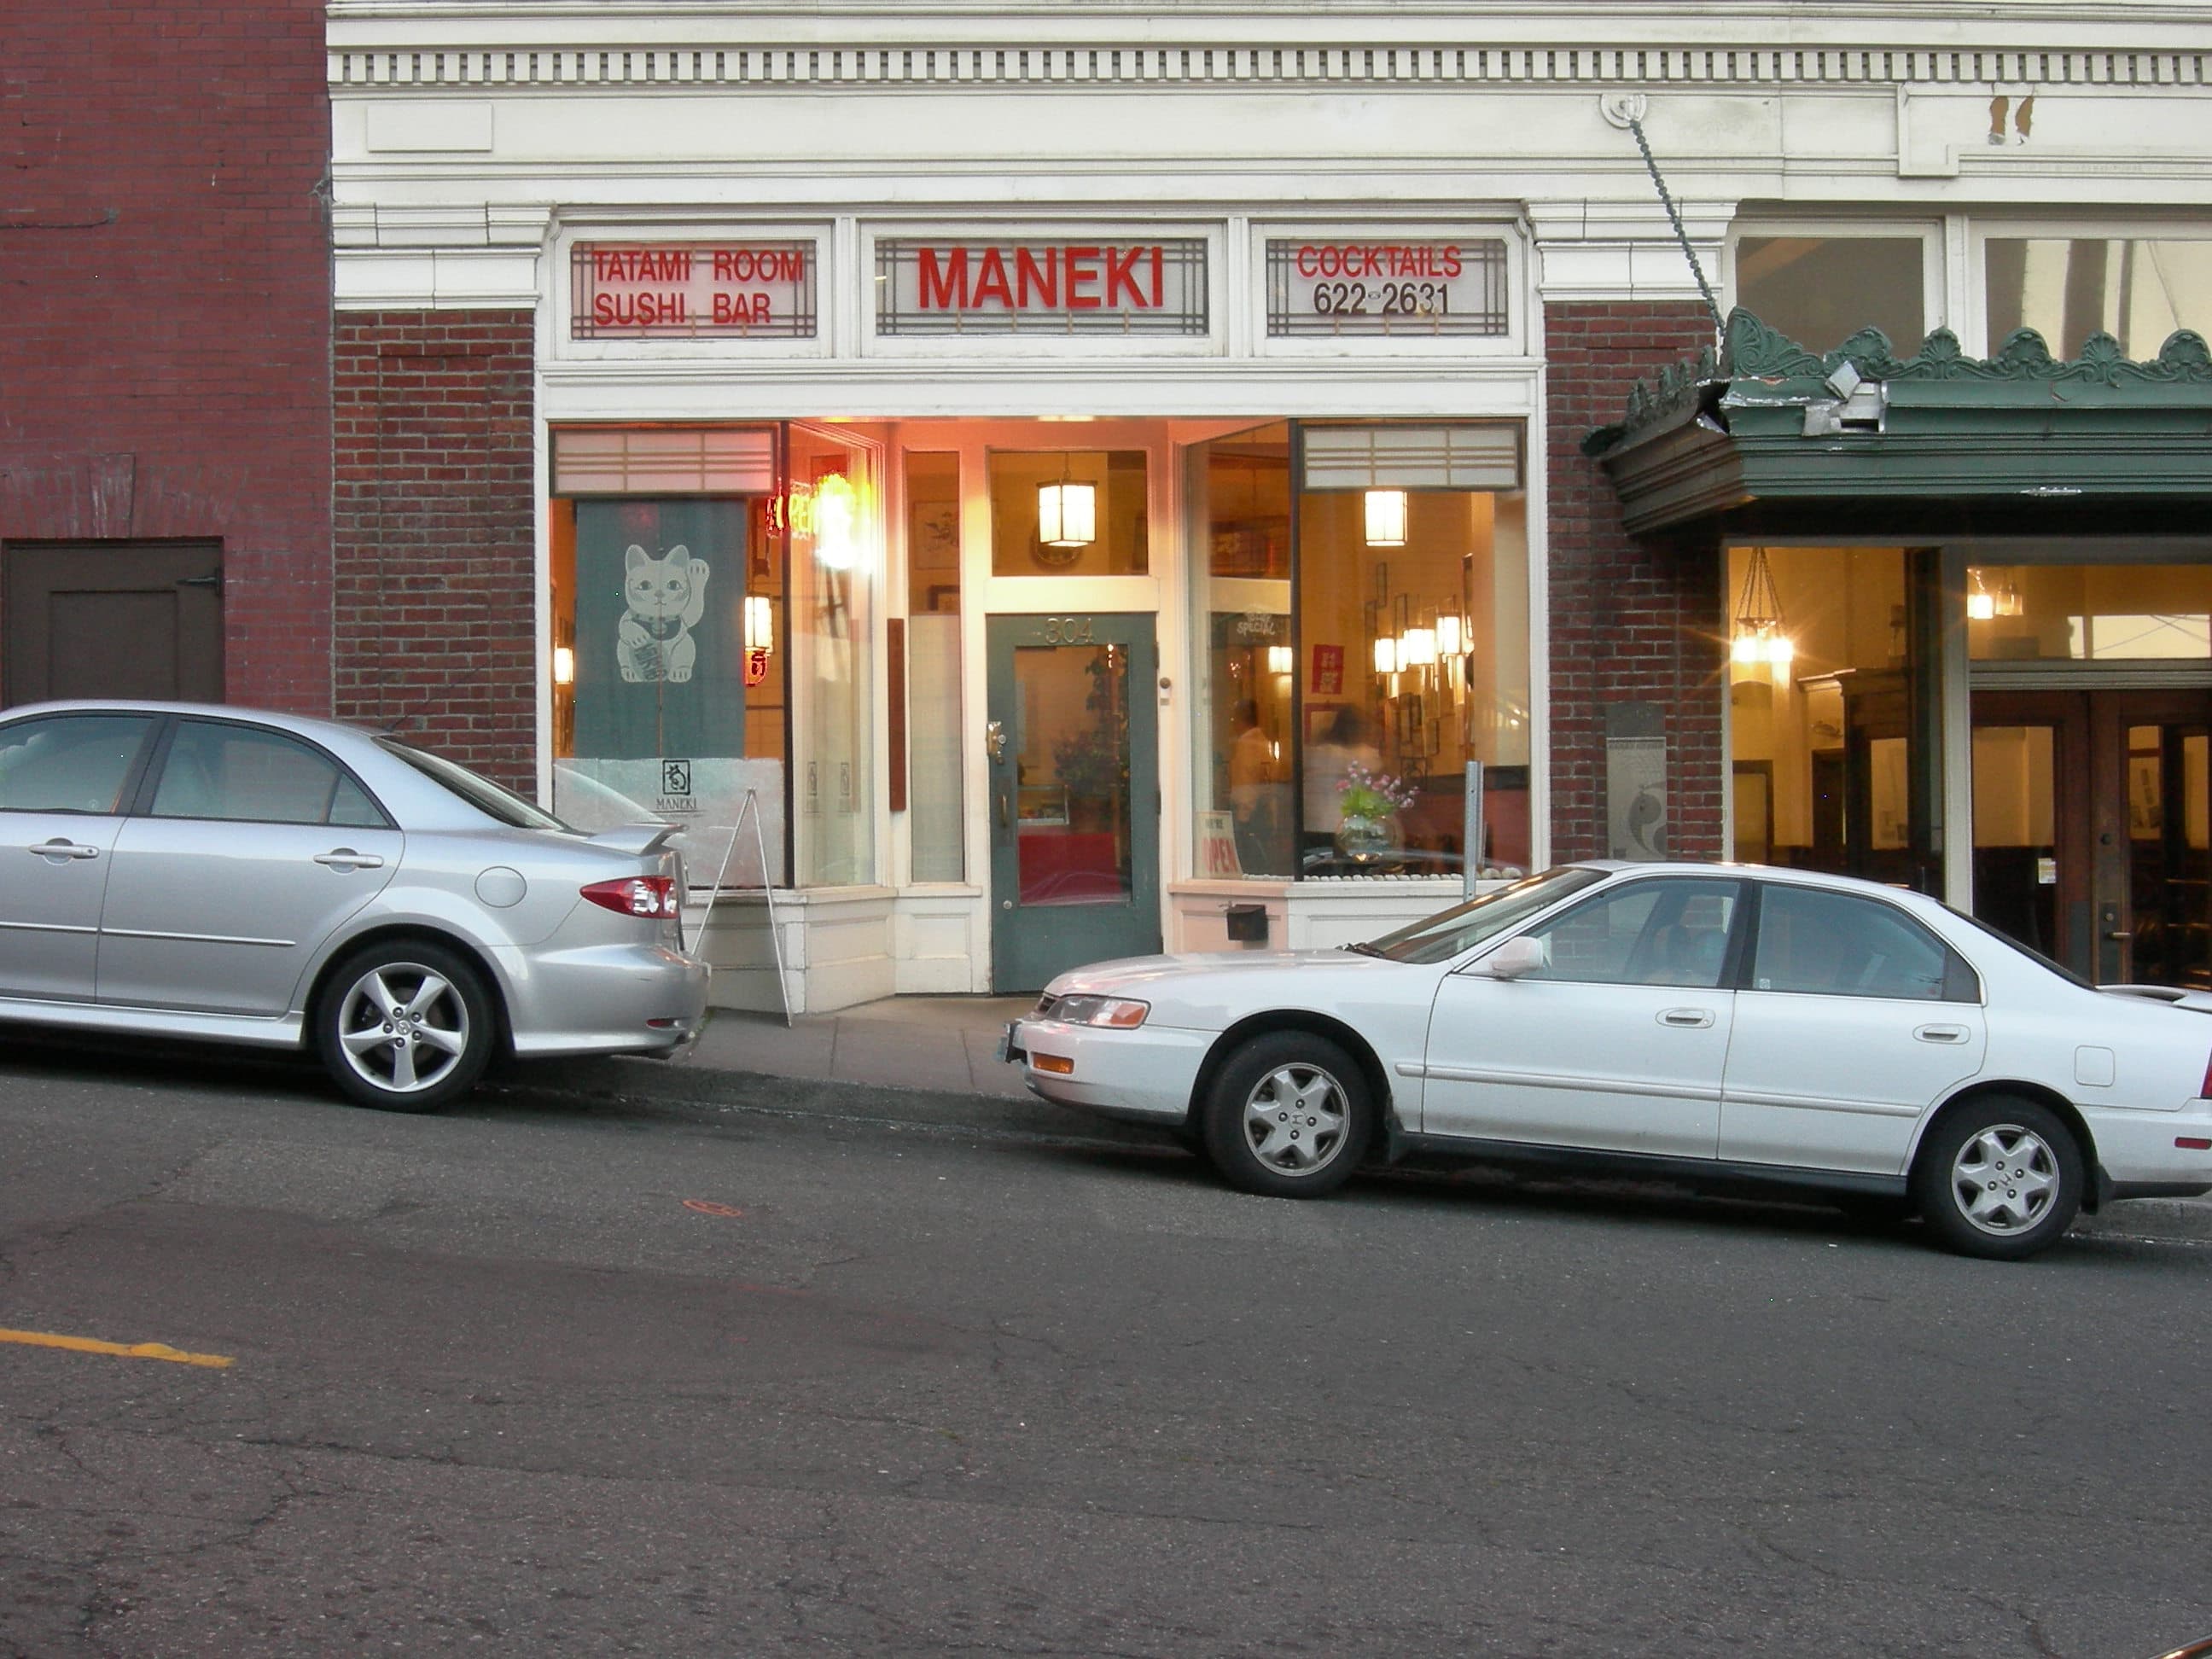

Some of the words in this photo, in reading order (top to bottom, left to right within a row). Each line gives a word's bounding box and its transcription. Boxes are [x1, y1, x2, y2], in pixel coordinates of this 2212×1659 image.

[591, 249, 690, 282] TATAMI
[713, 249, 804, 282] ROOM
[917, 246, 1163, 310] MANEKI
[1296, 245, 1462, 278] COCKTAILS
[593, 291, 685, 325] SUSHI
[712, 292, 771, 325] BAR
[1045, 618, 1094, 643] 304
[656, 798, 697, 809] MANEKI
[1201, 837, 1237, 872] OPEN
